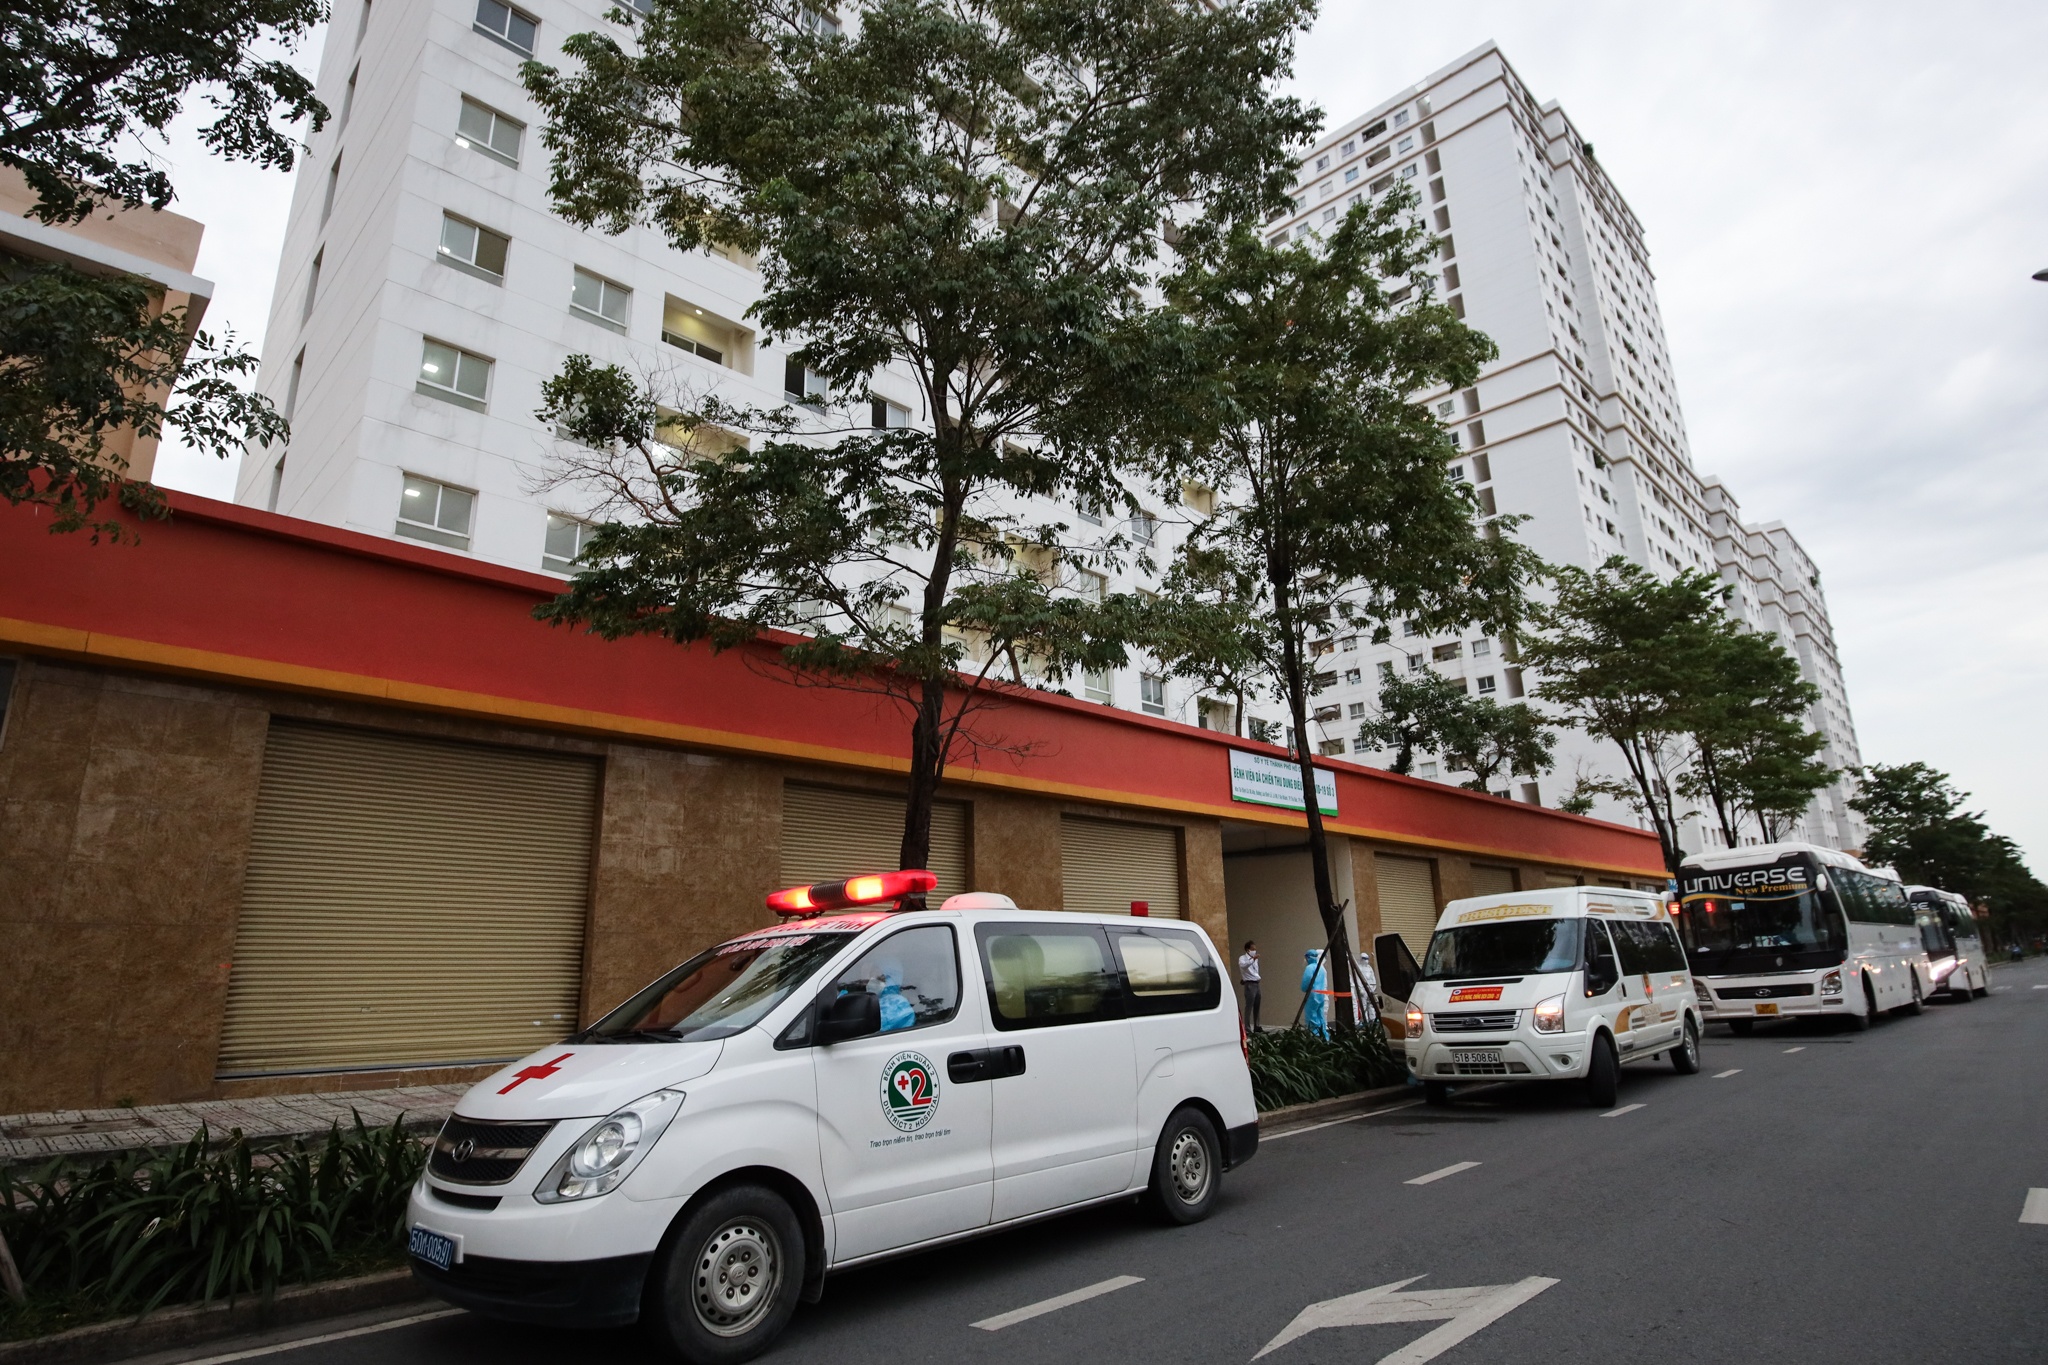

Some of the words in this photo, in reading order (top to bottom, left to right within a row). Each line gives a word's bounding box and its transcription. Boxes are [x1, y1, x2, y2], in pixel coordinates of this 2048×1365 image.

[1684, 866, 1806, 894] UNIVERSE
[1735, 886, 1758, 895] New
[1761, 883, 1808, 893] Premium
[883, 1061, 896, 1081] BỆNH
[896, 1053, 912, 1062] VIỆN
[913, 1054, 931, 1071] QUẬN
[909, 1068, 932, 1106] 2
[883, 1100, 908, 1129] DISTRICT
[915, 1094, 938, 1128] HOSPITAL
[870, 1140, 882, 1148] Trao
[915, 1133, 924, 1141] trao
